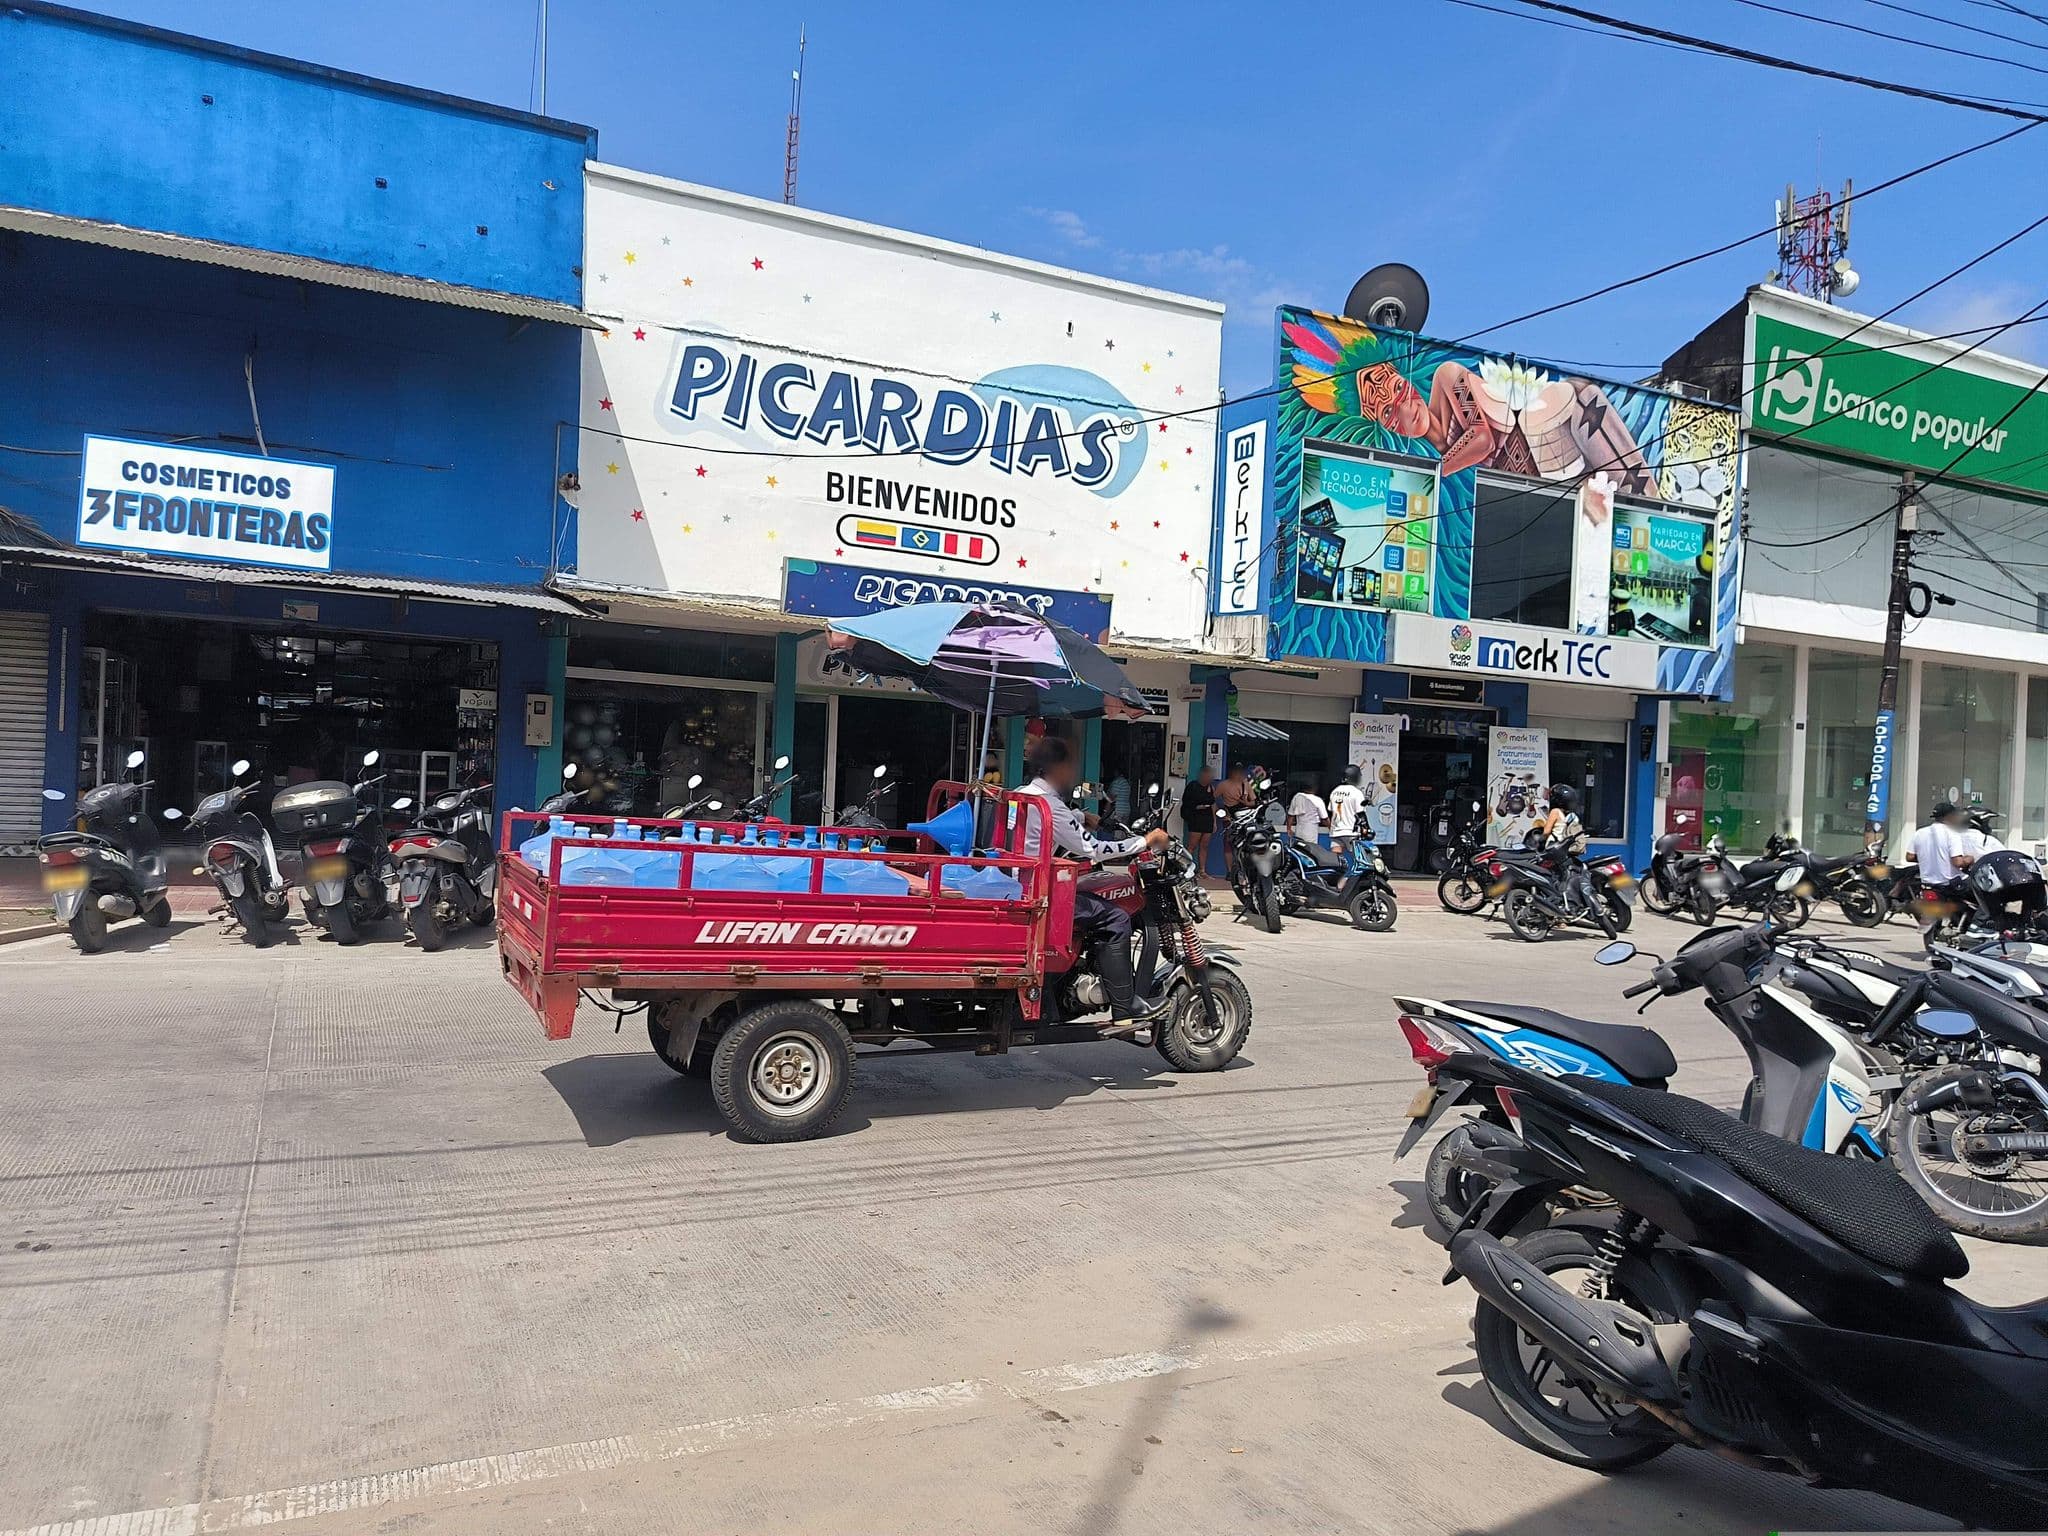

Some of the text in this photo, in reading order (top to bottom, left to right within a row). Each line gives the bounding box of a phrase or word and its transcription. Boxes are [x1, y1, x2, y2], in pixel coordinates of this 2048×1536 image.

[671, 345, 1116, 486] PICARDIAS
[1822, 378, 2008, 453] banco popular
[121, 460, 292, 500] COSMETICOS
[1322, 469, 1388, 489] TODO EN
[826, 471, 1017, 529] BIENVENIDOS
[1652, 526, 1701, 541] VARIEDAD EN
[1654, 538, 1698, 554] MARCAS
[1449, 653, 1472, 661] grupo
[1450, 660, 1469, 668] merk
[463, 698, 492, 707] VOGUE
[1866, 715, 1889, 813] FOTOCOPIAS
[694, 920, 918, 947] LIFAN CARGO
